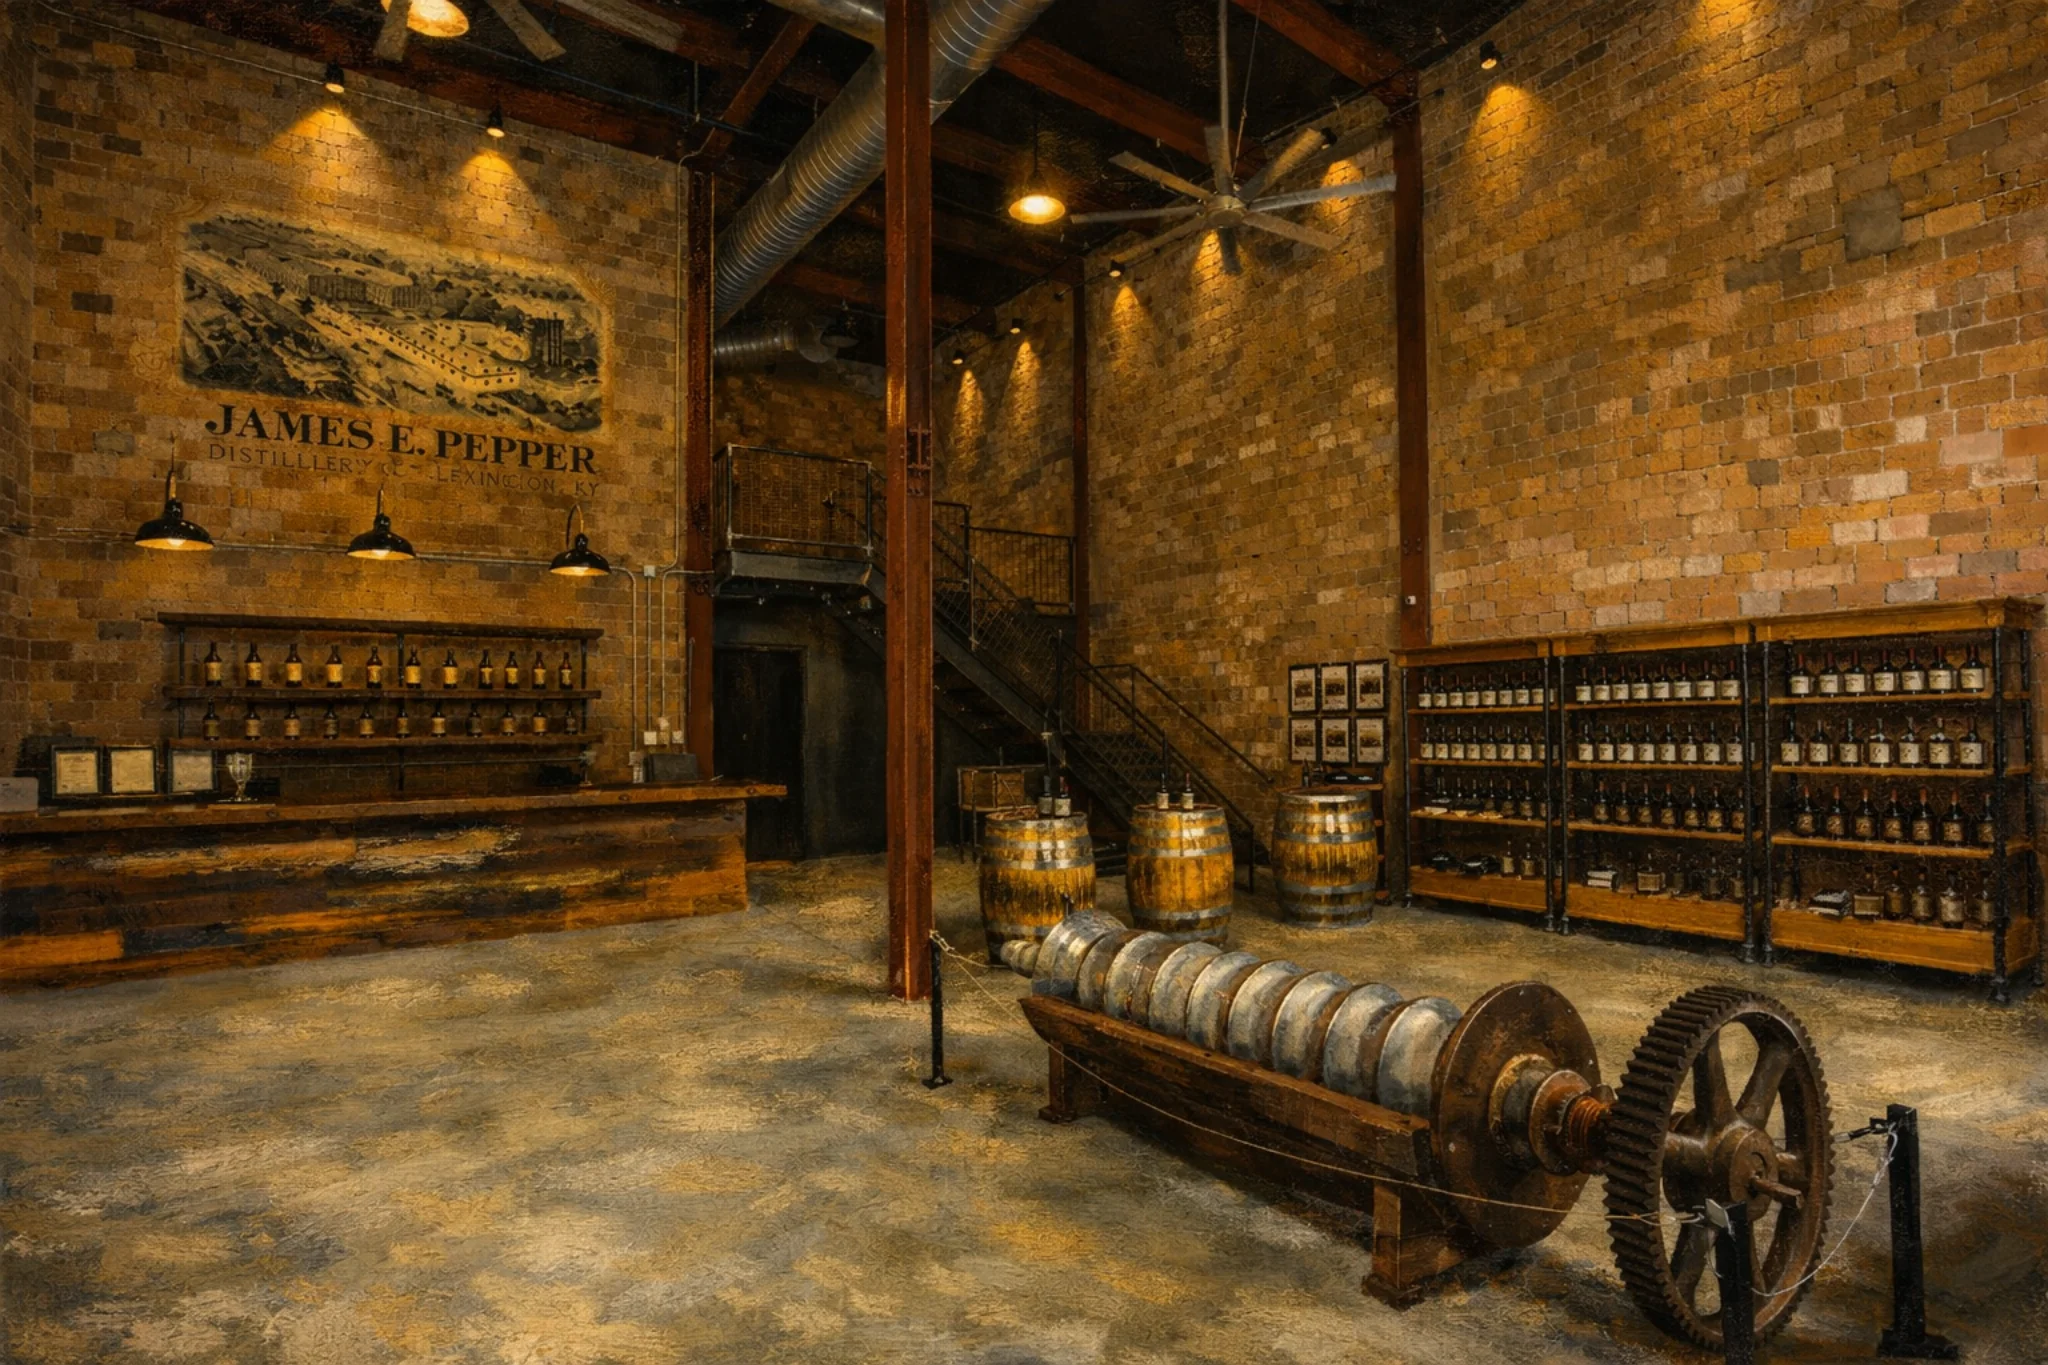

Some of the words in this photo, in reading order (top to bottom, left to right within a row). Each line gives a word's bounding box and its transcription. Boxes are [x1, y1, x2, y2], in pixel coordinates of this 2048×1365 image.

[205, 404, 374, 450] JAMES
[387, 423, 426, 454] E.
[435, 428, 597, 475] PEPPER
